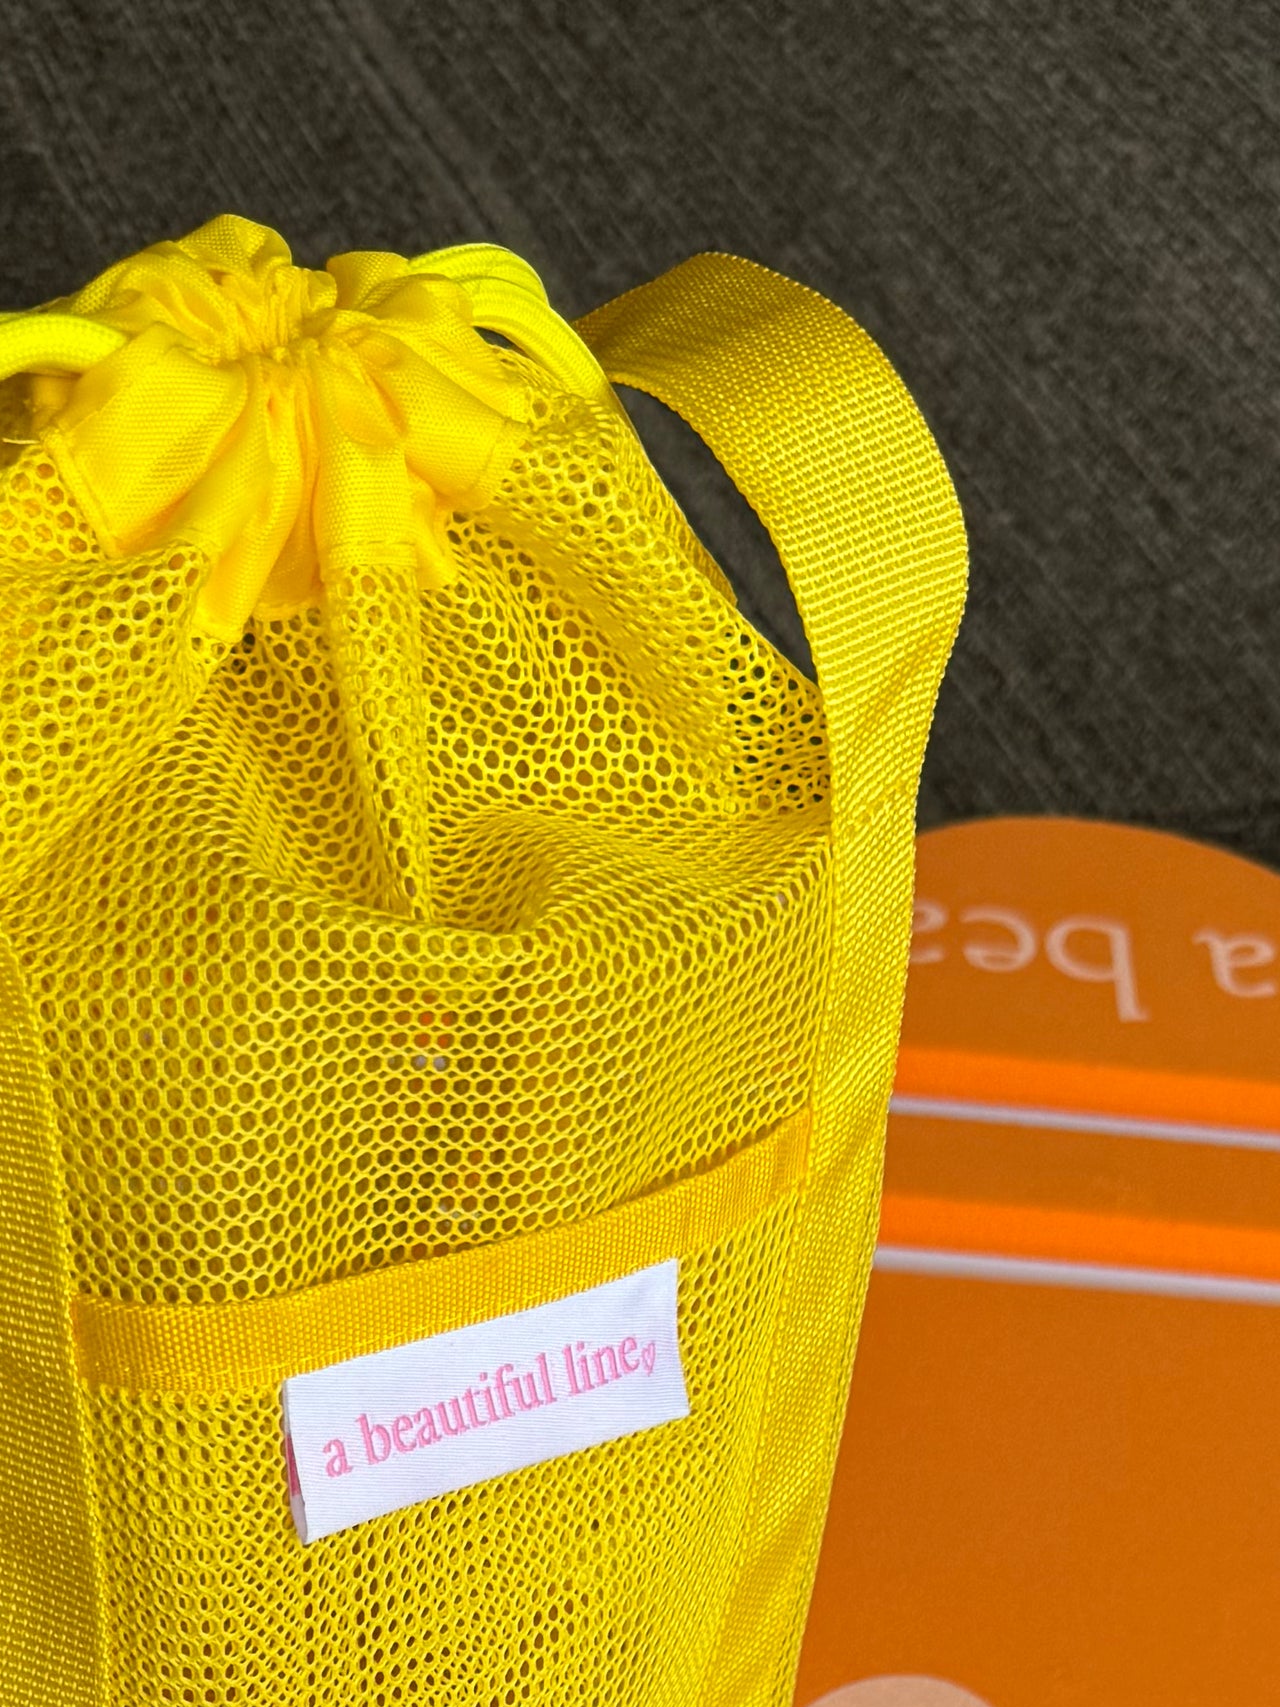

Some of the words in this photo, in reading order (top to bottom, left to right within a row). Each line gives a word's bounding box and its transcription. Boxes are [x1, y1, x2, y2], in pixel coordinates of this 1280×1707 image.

[1193, 926, 1278, 998] a
[322, 1436, 354, 1478] a
[355, 1353, 558, 1465] beautiful
[563, 1336, 642, 1397] line
